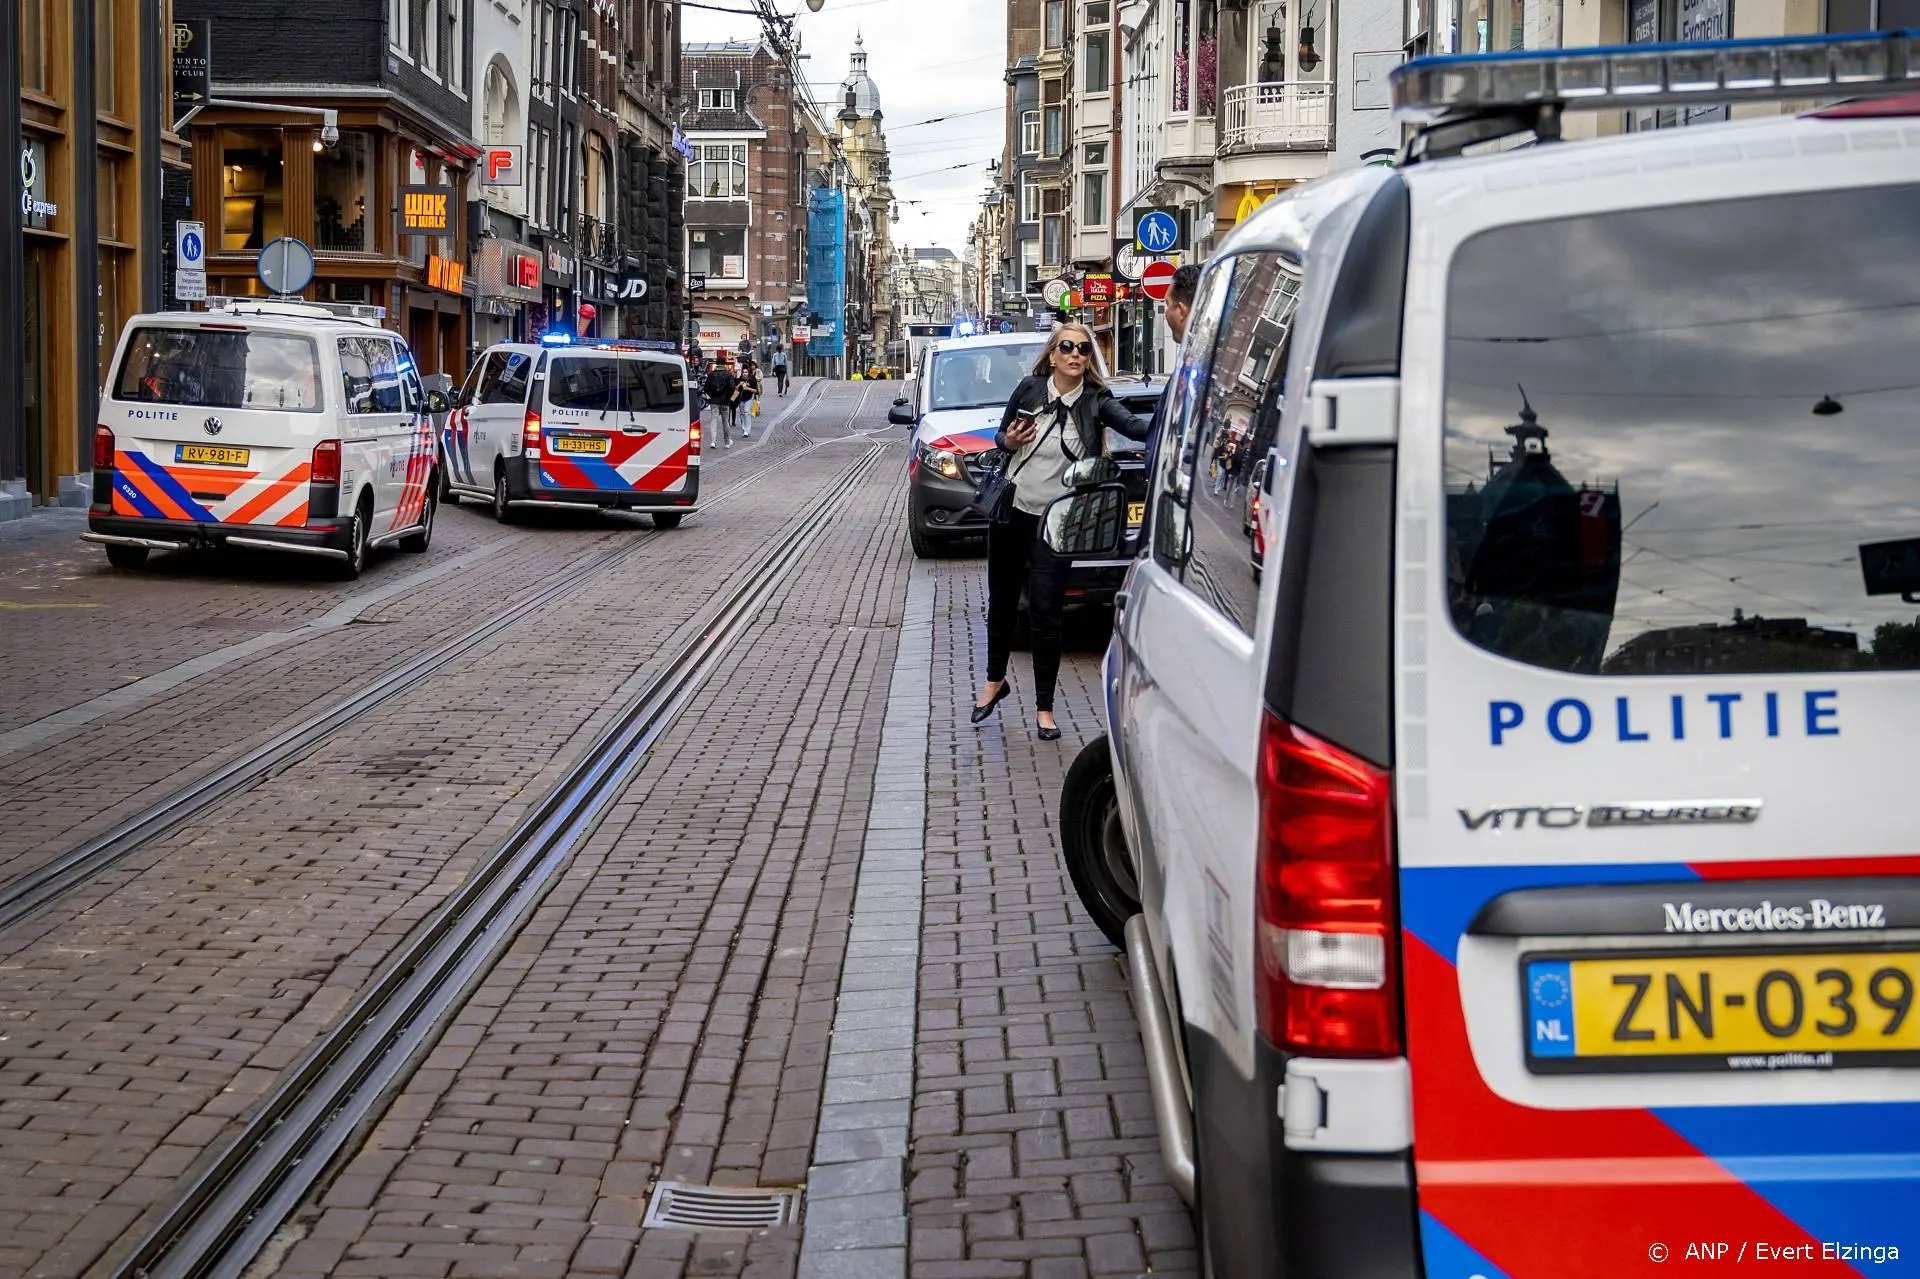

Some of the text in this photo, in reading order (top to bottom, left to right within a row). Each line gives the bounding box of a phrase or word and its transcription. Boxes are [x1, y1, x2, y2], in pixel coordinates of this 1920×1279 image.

[1636, 22, 1650, 42] OVER
[489, 150, 513, 180] F
[405, 194, 447, 215] WOK
[405, 215, 446, 228] TO WALK
[620, 279, 647, 298] JD
[128, 410, 178, 420] POLITIE
[552, 408, 590, 417] POLITIE
[188, 447, 243, 462] RV-981-F
[562, 440, 601, 450] H-331-HS
[1488, 689, 1841, 747] POLITIE
[1596, 804, 1756, 827] TOURER
[1662, 898, 1886, 933] Mercedes-Benz
[1536, 964, 1915, 1042] NL ZN-039
[1727, 1052, 1833, 1069] www.politie.nl
